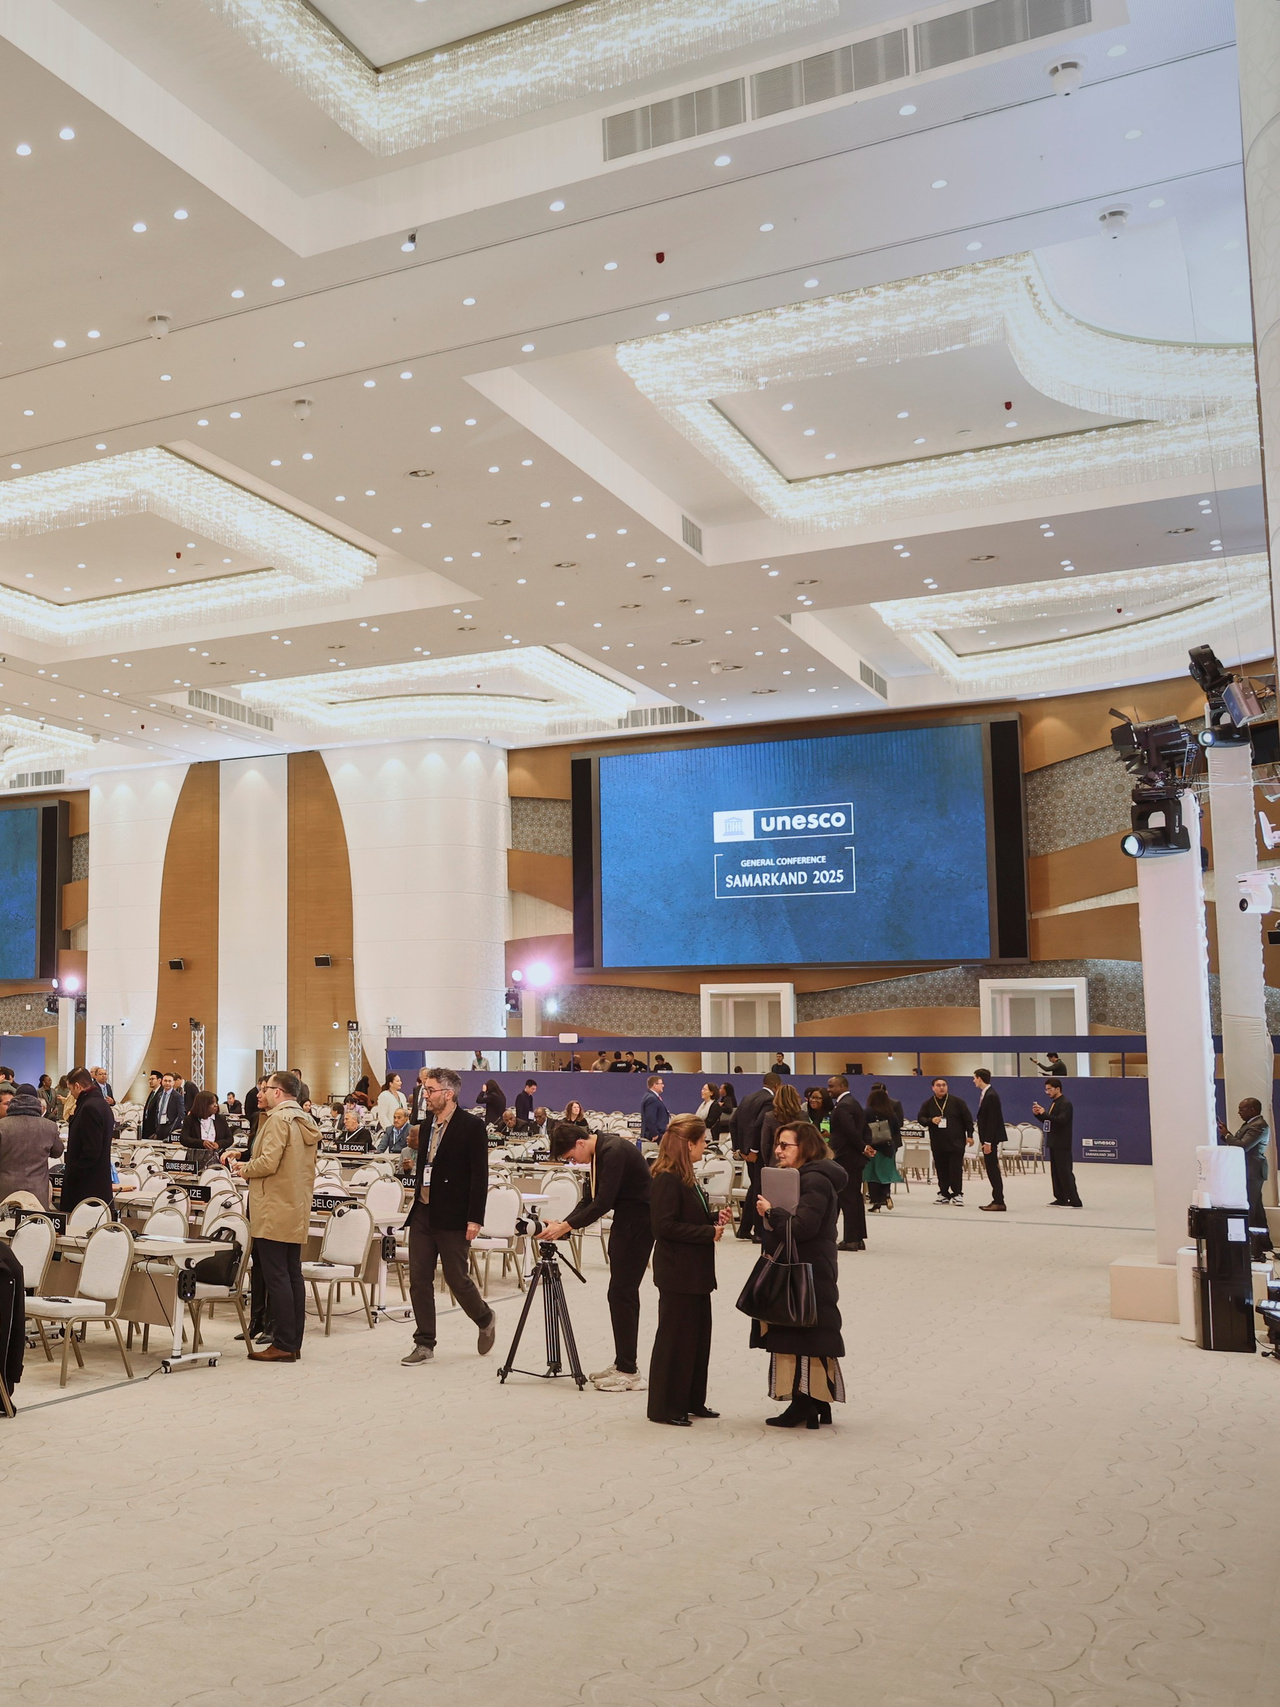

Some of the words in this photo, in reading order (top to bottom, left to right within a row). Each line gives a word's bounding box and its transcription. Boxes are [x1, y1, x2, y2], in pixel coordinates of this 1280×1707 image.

[761, 812, 846, 832] unesco
[741, 858, 775, 868] GENERAL
[776, 855, 826, 866] CONFERENCE
[725, 871, 807, 888] SAMARKAND
[812, 869, 844, 885] 2025
[350, 1144, 365, 1152] COOK
